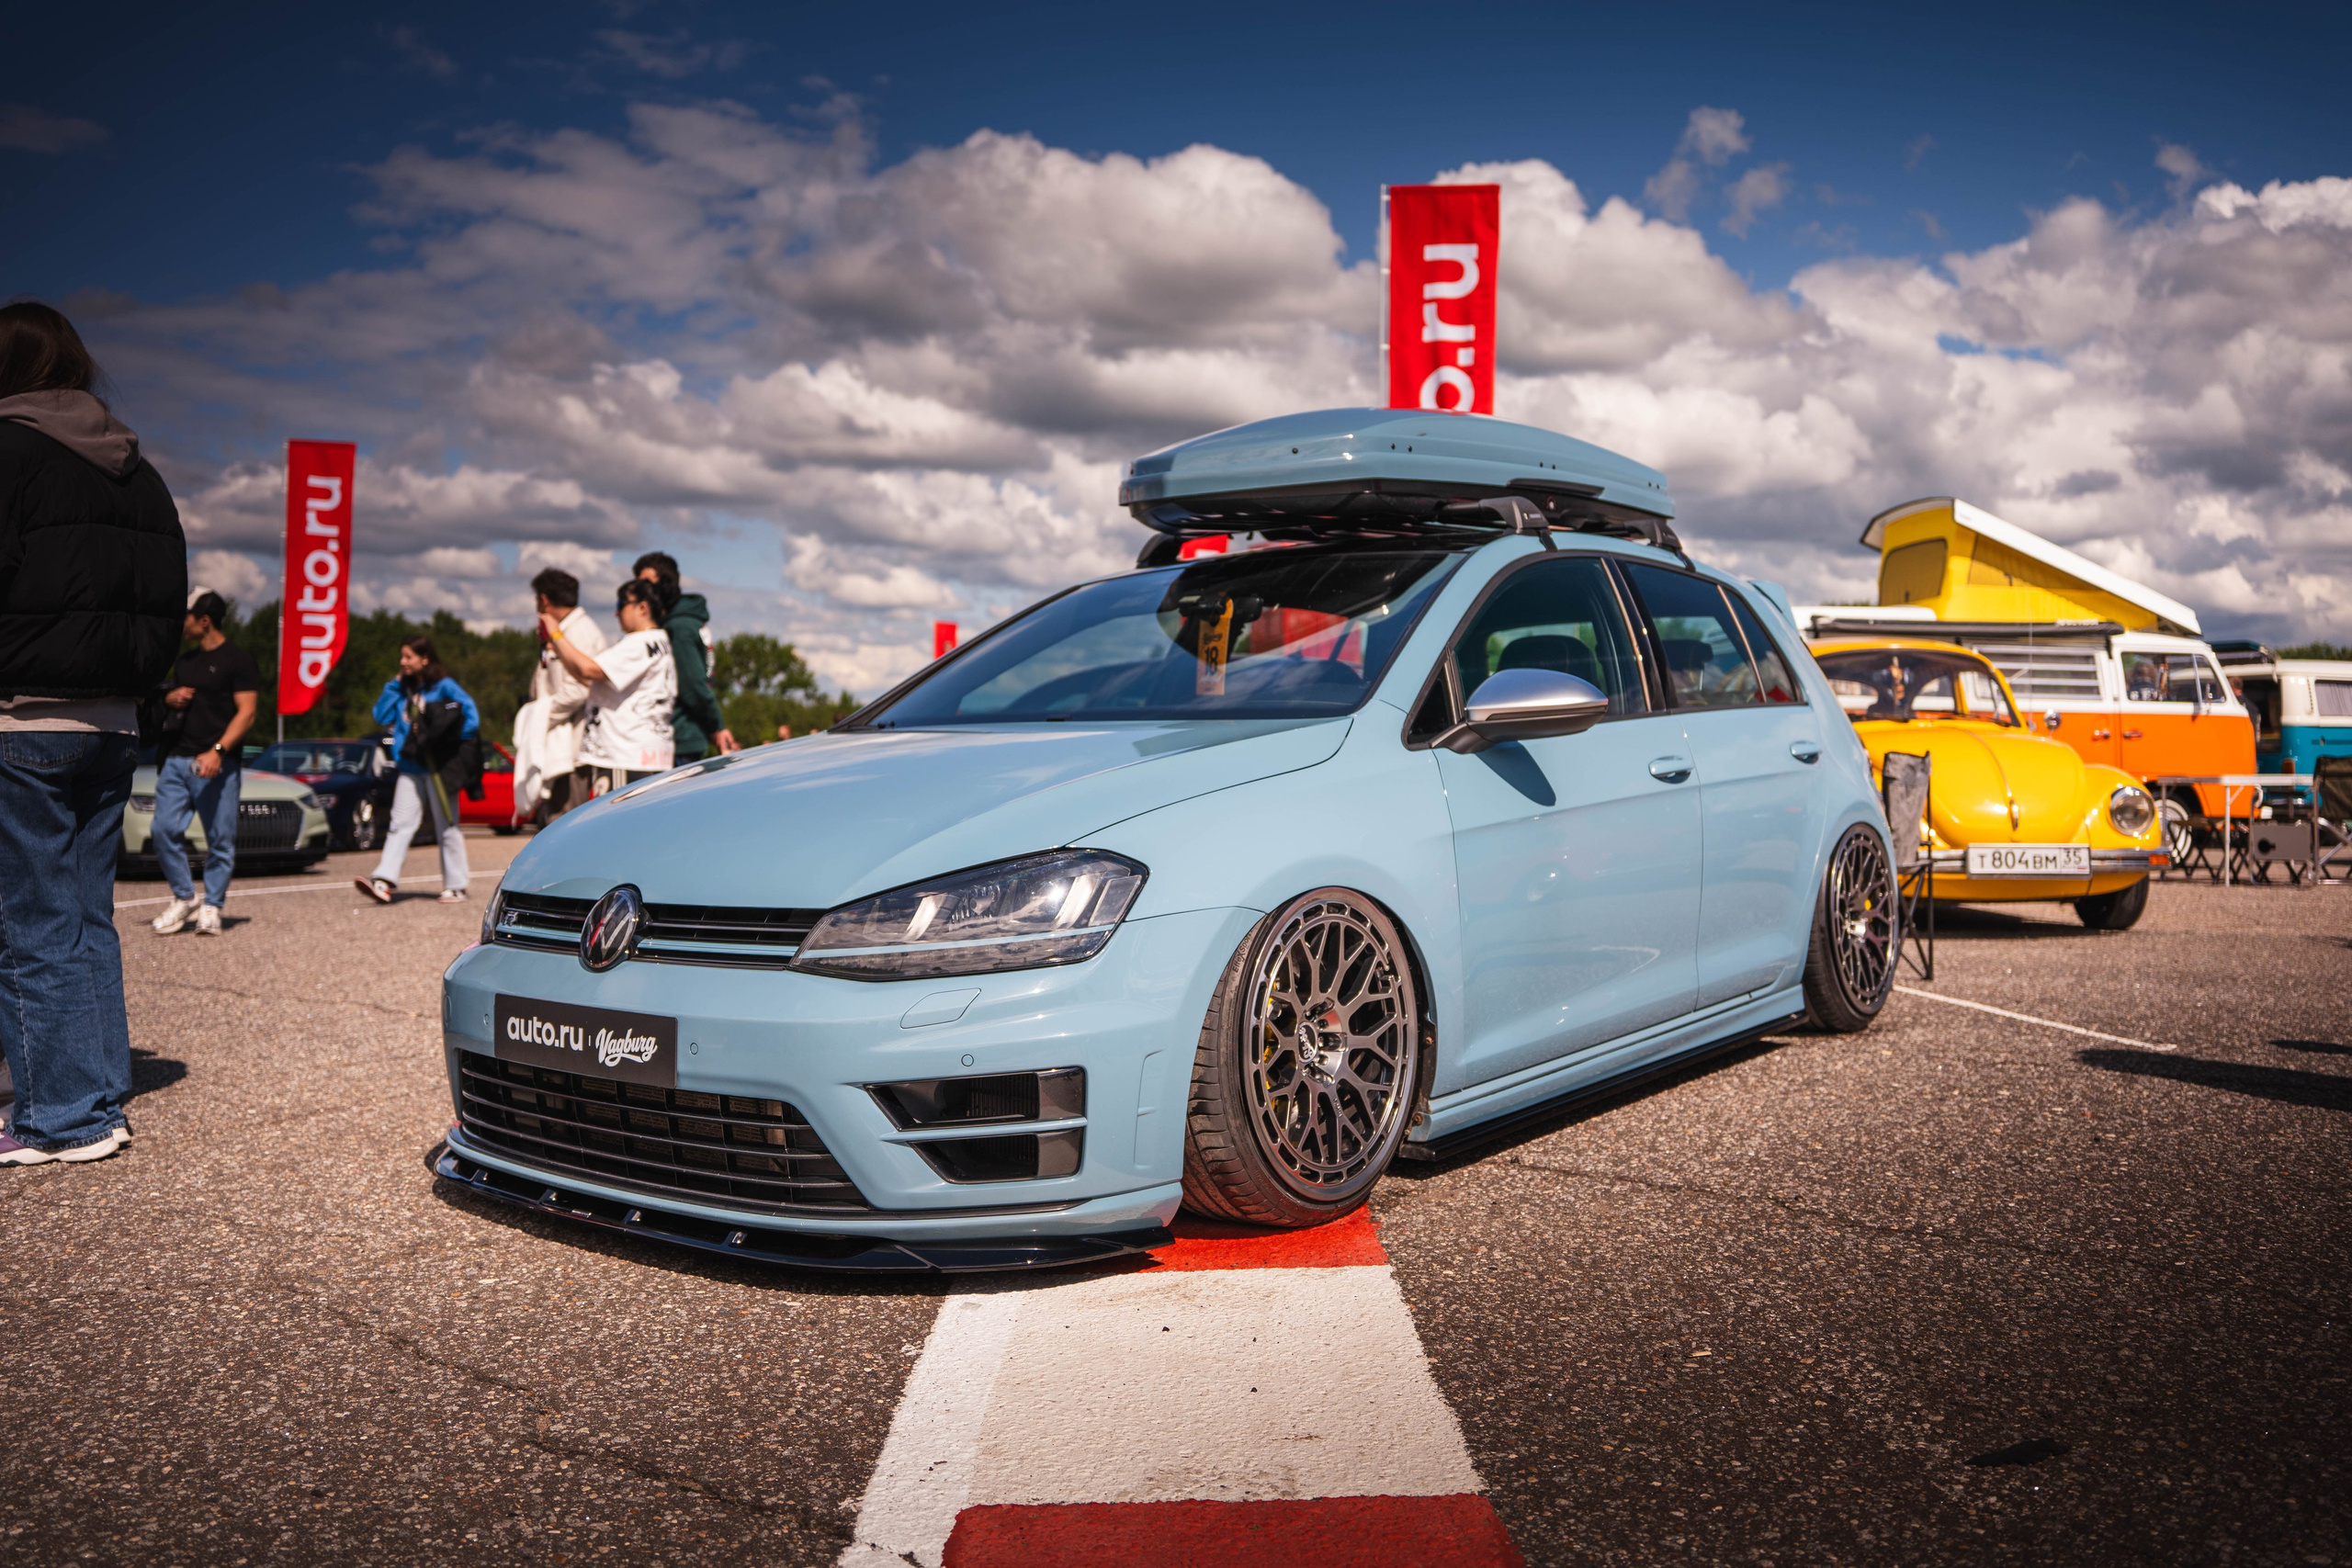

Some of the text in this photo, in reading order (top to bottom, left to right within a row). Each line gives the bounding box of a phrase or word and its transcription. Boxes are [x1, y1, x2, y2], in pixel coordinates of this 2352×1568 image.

[296, 475, 343, 688] auto.ru
[2064, 849, 2083, 864] 35
[507, 1016, 658, 1067] auto.ru Vagburg
